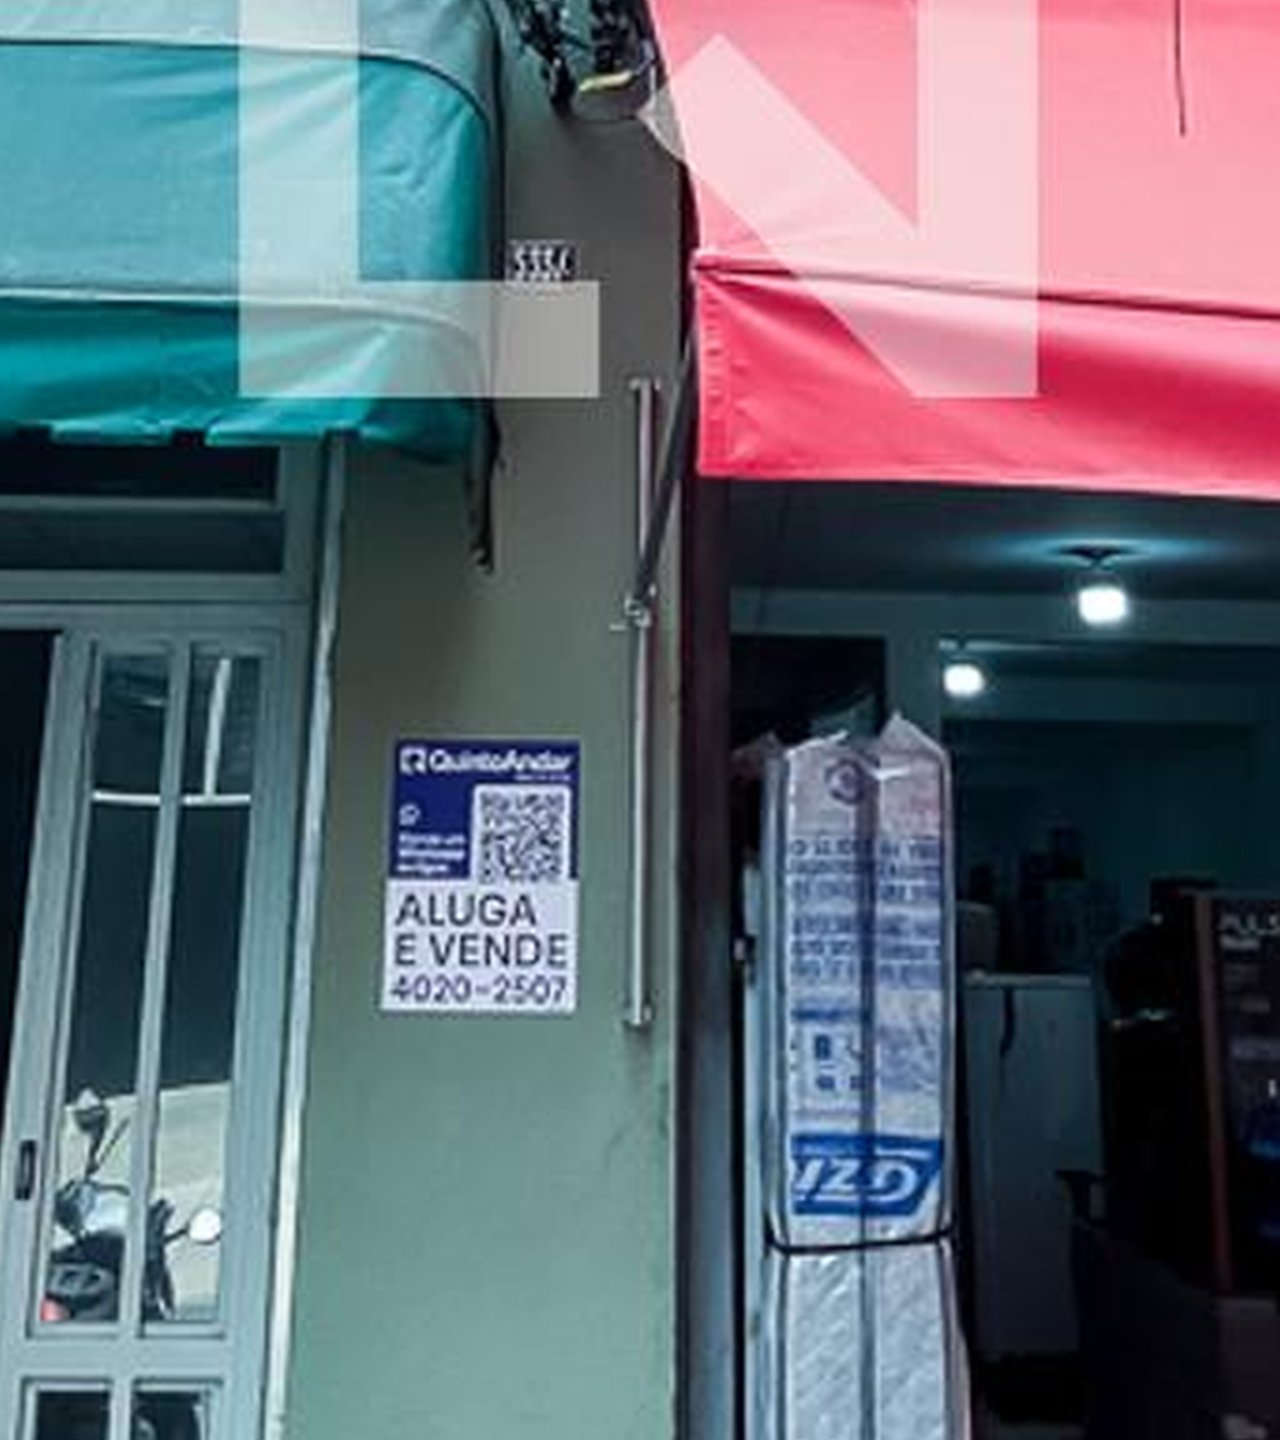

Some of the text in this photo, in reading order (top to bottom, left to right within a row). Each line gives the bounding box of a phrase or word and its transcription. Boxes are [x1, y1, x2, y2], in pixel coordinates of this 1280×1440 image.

[429, 747, 574, 775] QuintoAndar
[394, 893, 538, 928] ALUGA
[394, 932, 568, 969] E VENDE
[390, 972, 568, 1005] 4020-2507
